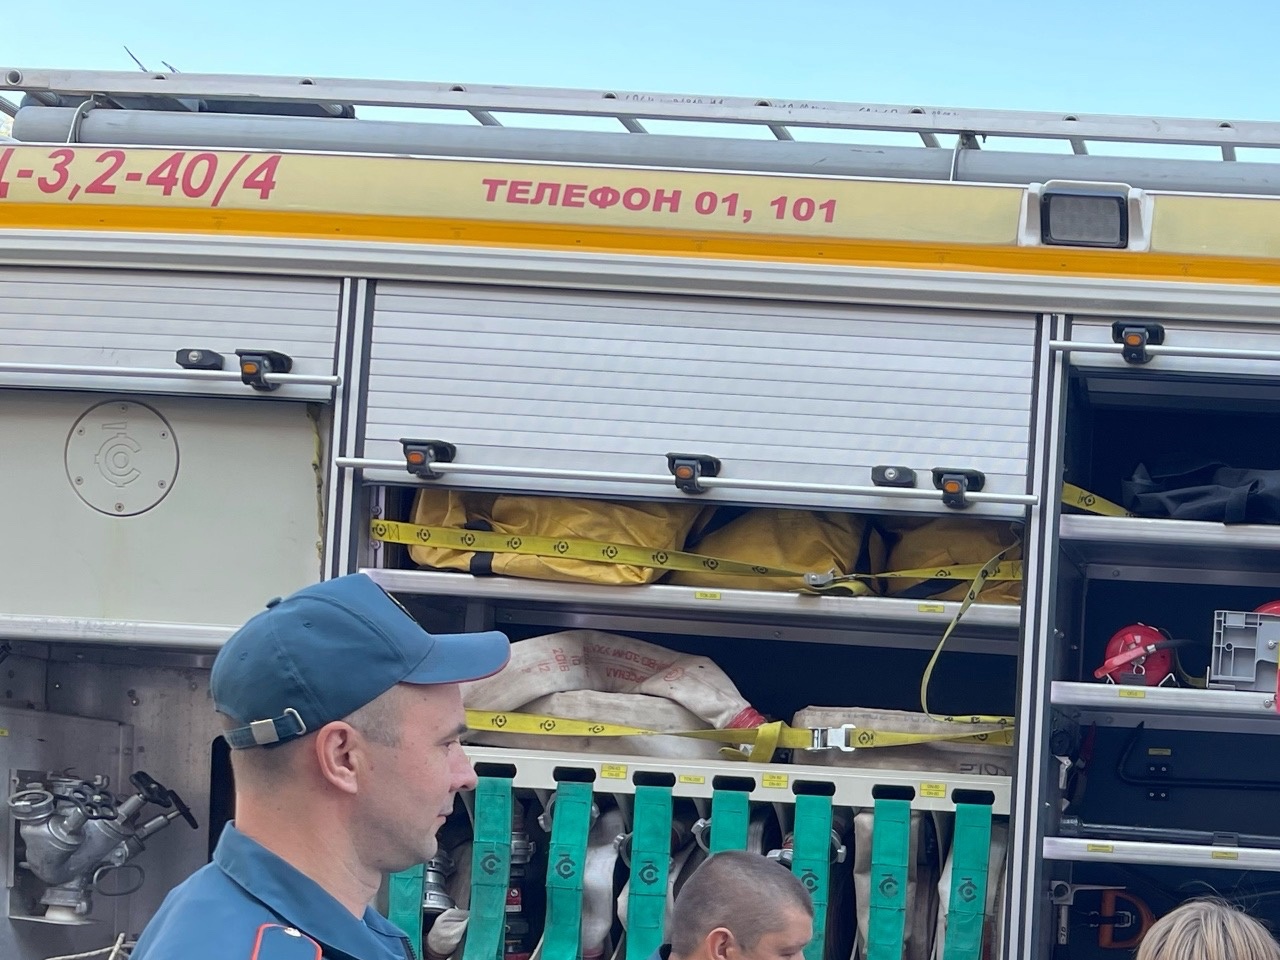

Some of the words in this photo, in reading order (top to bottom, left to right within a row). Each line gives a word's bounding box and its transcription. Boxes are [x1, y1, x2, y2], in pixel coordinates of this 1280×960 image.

[482, 178, 682, 213] ТЕЛЕФОН
[695, 191, 753, 224] 01,
[770, 196, 837, 223] 101
